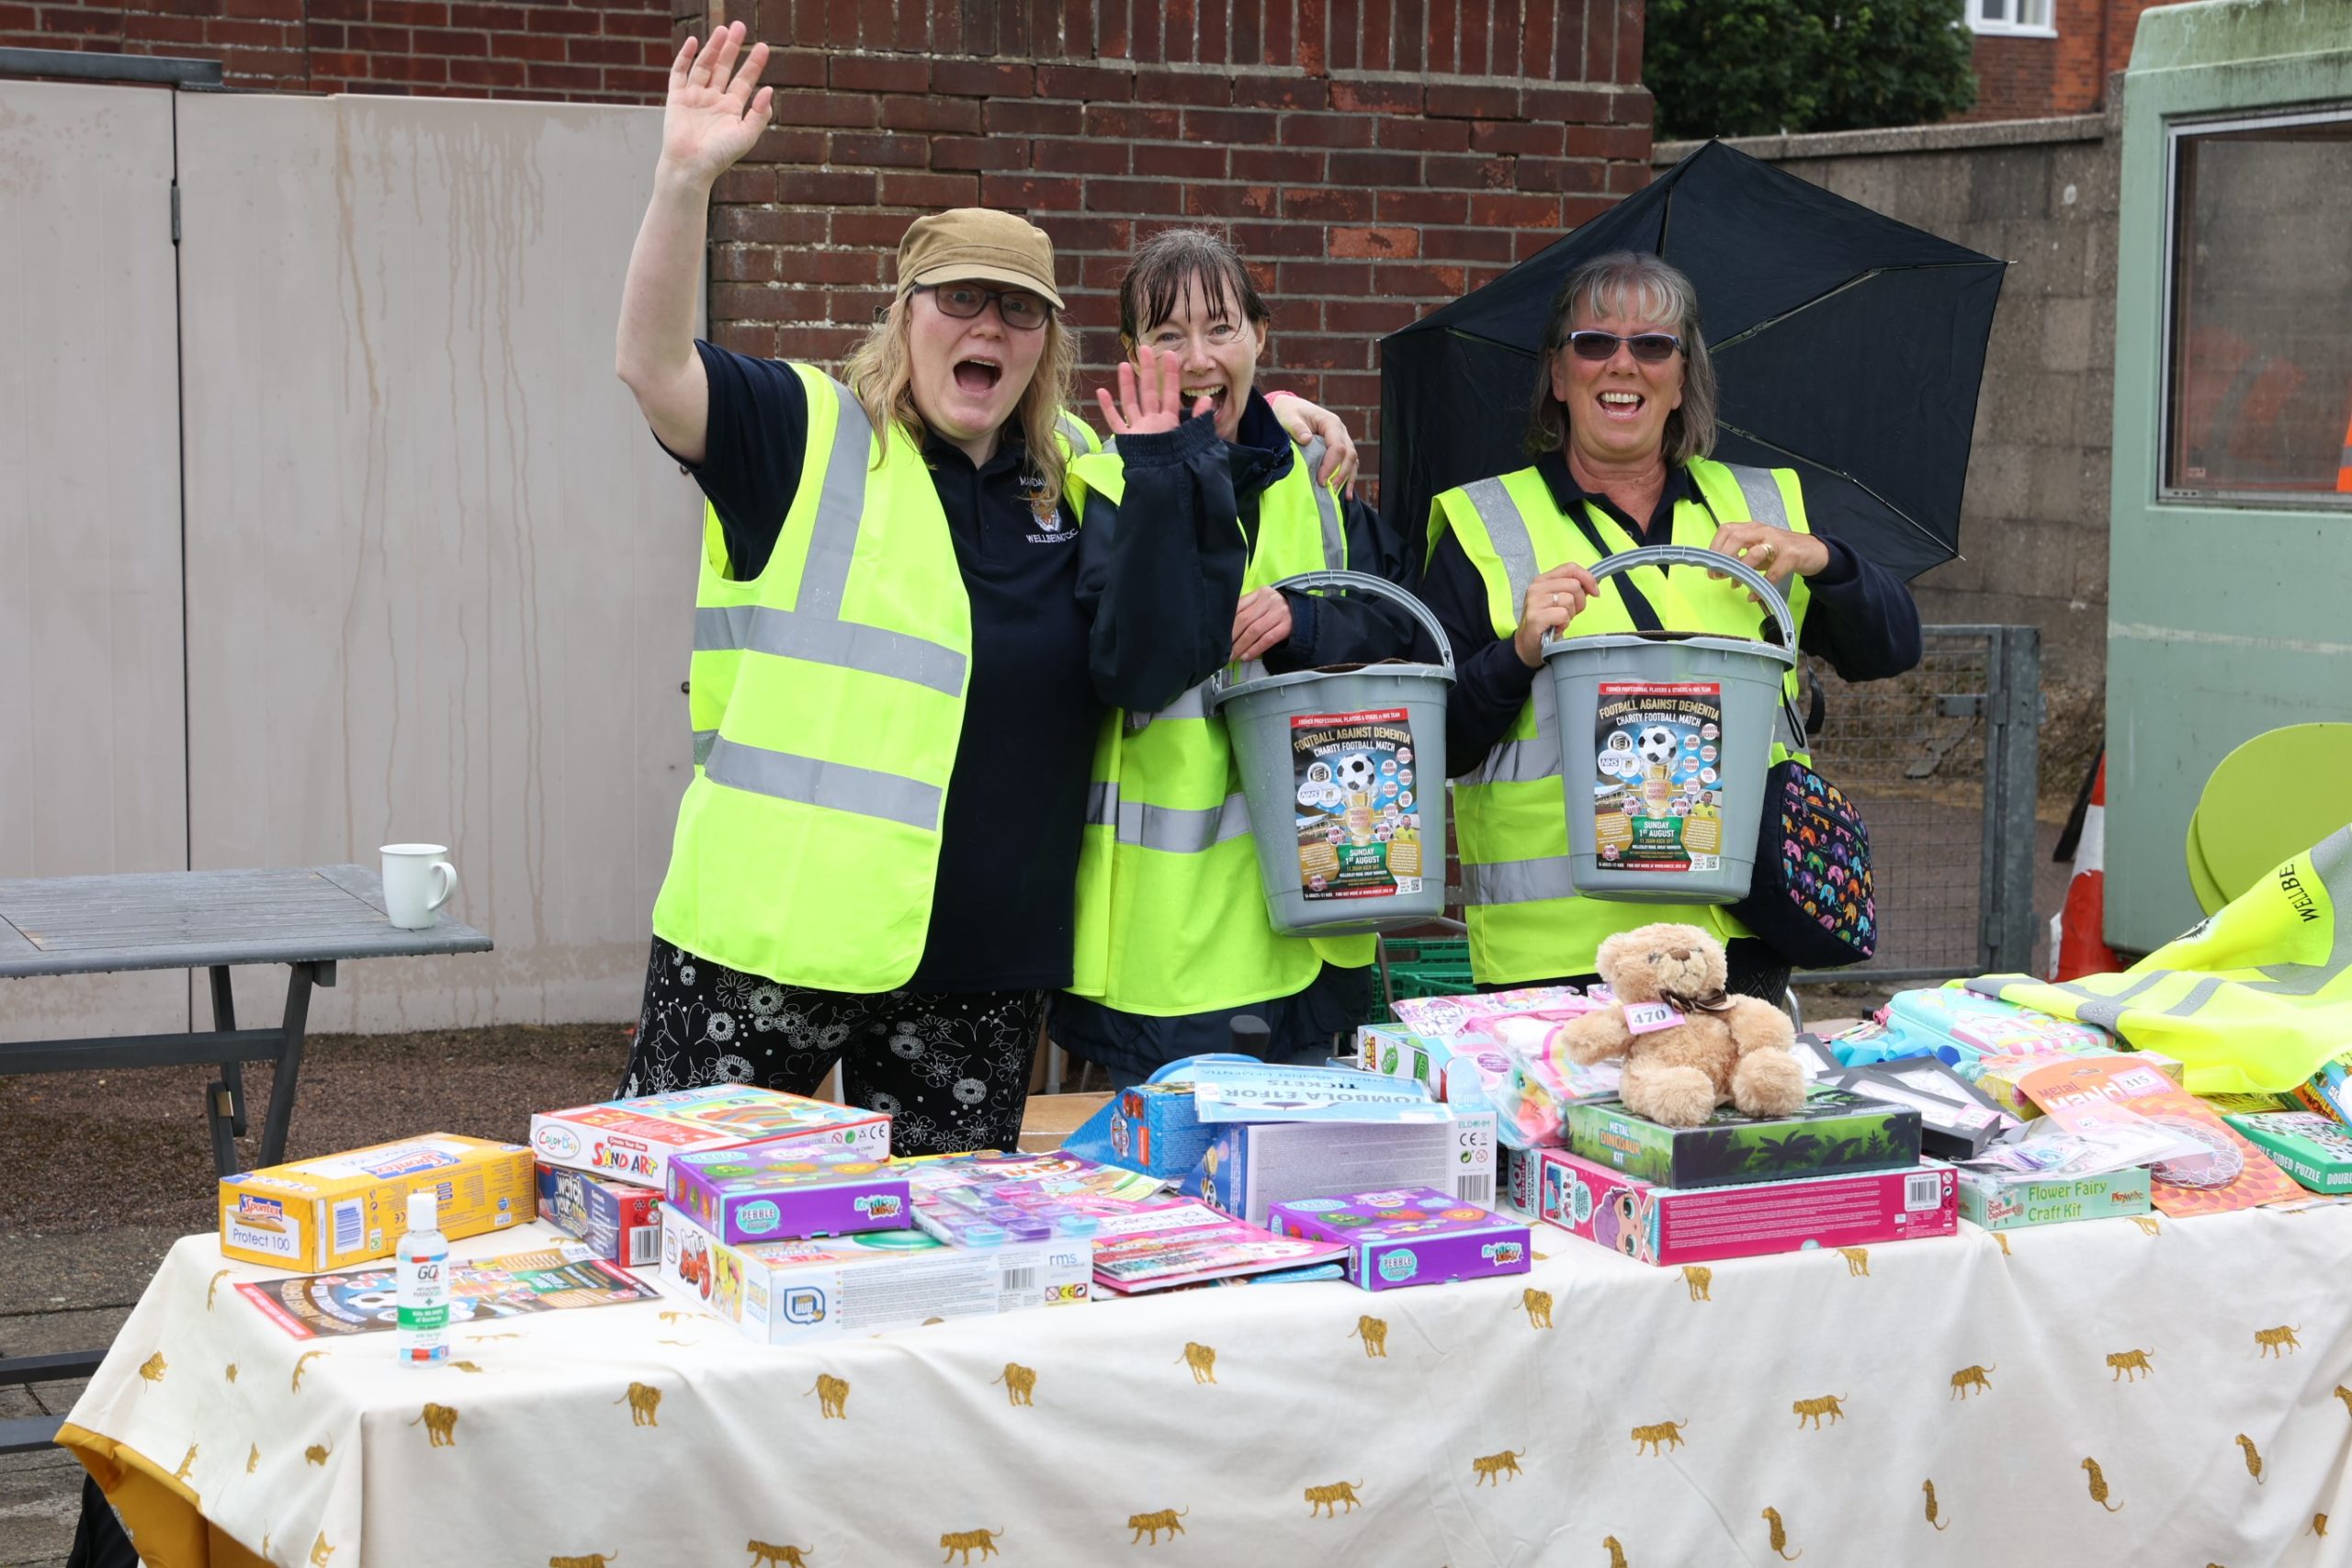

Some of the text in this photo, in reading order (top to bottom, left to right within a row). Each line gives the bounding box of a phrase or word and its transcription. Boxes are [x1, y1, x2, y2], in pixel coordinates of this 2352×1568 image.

[1599, 699, 1720, 721] FOOTBALL AGAINST DEMENTIA
[1616, 712, 1701, 727] CHARITY FOOTBALL MATCH
[1294, 726, 1411, 753] FOOTBALL AGAINST DEMENTIA
[1313, 741, 1395, 757] CHARITY FOOTBALL MATCH
[1600, 758, 1619, 766] NHS
[1349, 848, 1374, 856] SUNDAY
[1355, 856, 1379, 864] AUGUST
[2278, 863, 2321, 923] WELLBE
[1634, 1010, 1666, 1024] 470
[1267, 1079, 1360, 1090] TICKETS
[1305, 1091, 1424, 1103] TOMBOLA
[2304, 1081, 2332, 1113] MIDDLE
[1609, 1120, 1630, 1137] METAL
[1600, 1131, 1640, 1156] DINOSAUR
[370, 1151, 443, 1175] Spontex
[592, 1142, 658, 1178] SAND ART
[1613, 1151, 1624, 1164] KIT
[2296, 1162, 2321, 1183] PUZZLE
[2028, 1180, 2107, 1201] Flower Fairy
[243, 1196, 283, 1218] Spontex
[742, 1208, 775, 1220] PEBBLE
[1987, 1203, 2002, 1212] Craft
[1988, 1207, 2015, 1220] Cupboard
[2028, 1203, 2082, 1222] Craft Kit
[233, 1228, 290, 1251] Protect 100
[1049, 1252, 1078, 1266] rms
[1383, 1257, 1413, 1267] PEBBLE
[795, 1302, 813, 1314] HUB
